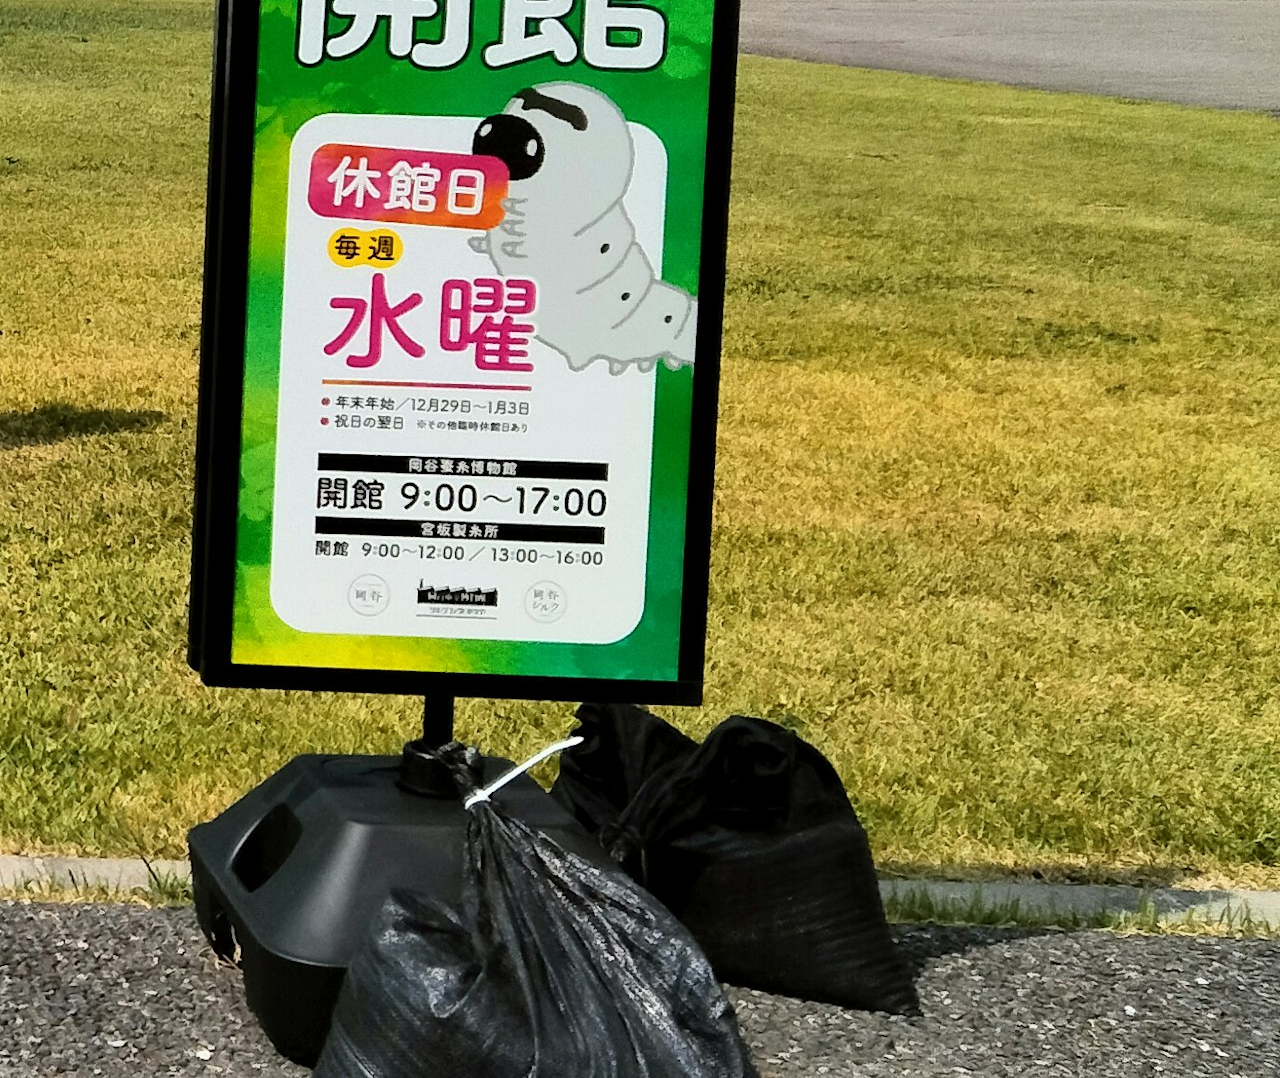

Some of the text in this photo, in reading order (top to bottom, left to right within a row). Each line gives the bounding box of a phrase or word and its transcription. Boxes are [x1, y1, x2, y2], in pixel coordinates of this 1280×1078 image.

[327, 155, 485, 216] 休館日
[334, 234, 395, 261] 毎週
[323, 272, 537, 373] 水曜
[334, 414, 404, 430] 祝日の翌日
[408, 457, 518, 476] 岡谷蚕糸博物館
[316, 477, 385, 510] 開館
[420, 522, 499, 539] 宮坂製糸所
[315, 540, 350, 557] 開館
